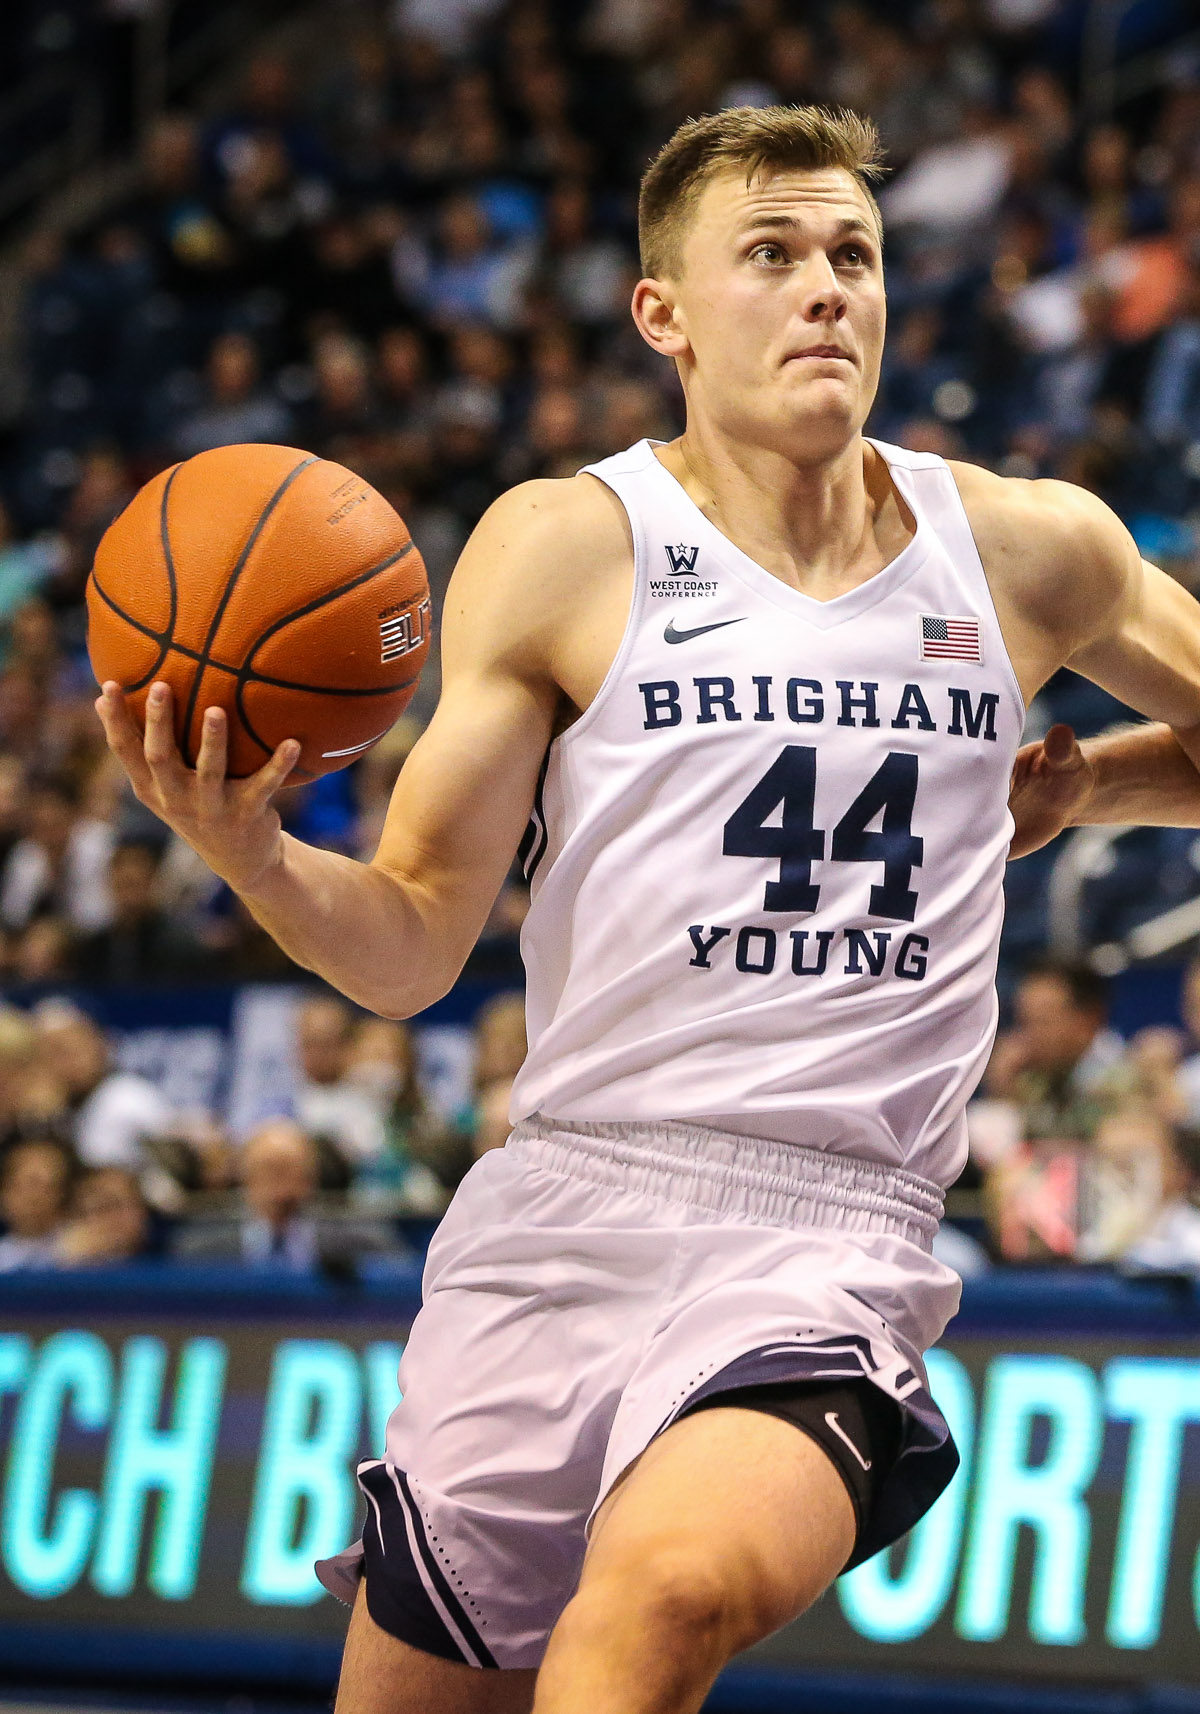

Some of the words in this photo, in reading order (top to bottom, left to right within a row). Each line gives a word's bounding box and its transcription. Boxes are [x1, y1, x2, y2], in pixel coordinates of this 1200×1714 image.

[649, 581, 681, 590] WEST
[684, 581, 718, 590] COAST
[638, 675, 1000, 741] BRIGHAM
[723, 745, 924, 922] 44
[687, 925, 930, 981] YOUNG
